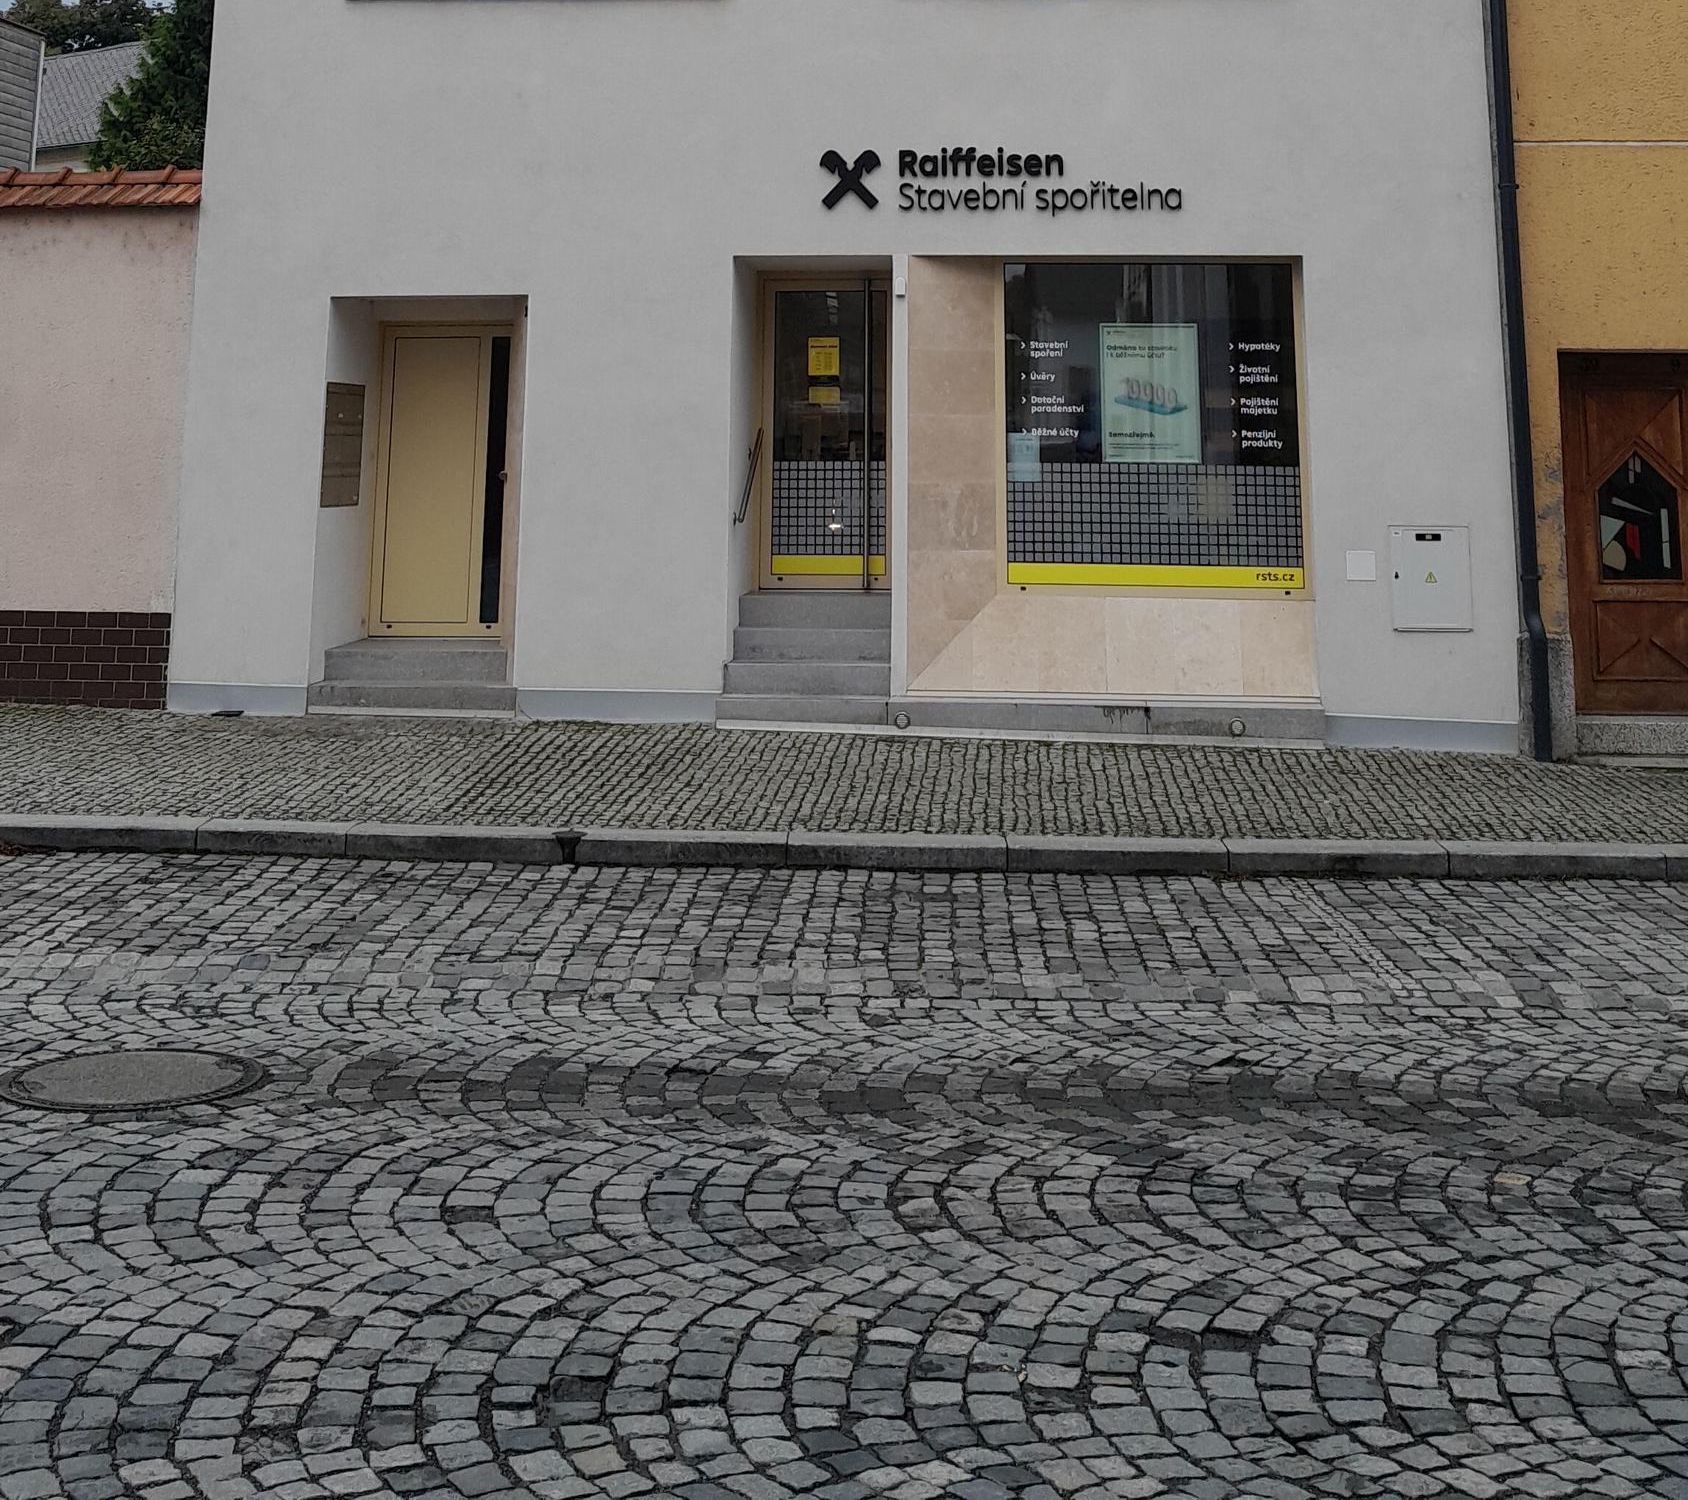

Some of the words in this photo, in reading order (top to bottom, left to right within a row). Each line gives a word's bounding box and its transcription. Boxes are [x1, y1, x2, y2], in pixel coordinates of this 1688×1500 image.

[898, 147, 1064, 177] Raiffeisen
[898, 180, 1027, 211] Stavební
[1035, 180, 1183, 217] spořitelna
[1030, 340, 1068, 349] Stavební
[1238, 342, 1280, 352] Hypotéky
[1030, 349, 1063, 358] spoření
[1239, 364, 1270, 373] Životní
[1030, 370, 1056, 382] Úvěry
[1239, 374, 1278, 384] pojištění
[1031, 395, 1065, 404] Dotační
[1240, 397, 1279, 407] Pojištění
[1031, 404, 1085, 414] poradenství
[1241, 407, 1278, 416] majetku
[1031, 427, 1057, 436] Běžné
[1059, 427, 1080, 438] účty
[1241, 429, 1277, 439] Penzijní
[1242, 439, 1283, 449] produkty
[1255, 570, 1295, 582] rsts.cz
